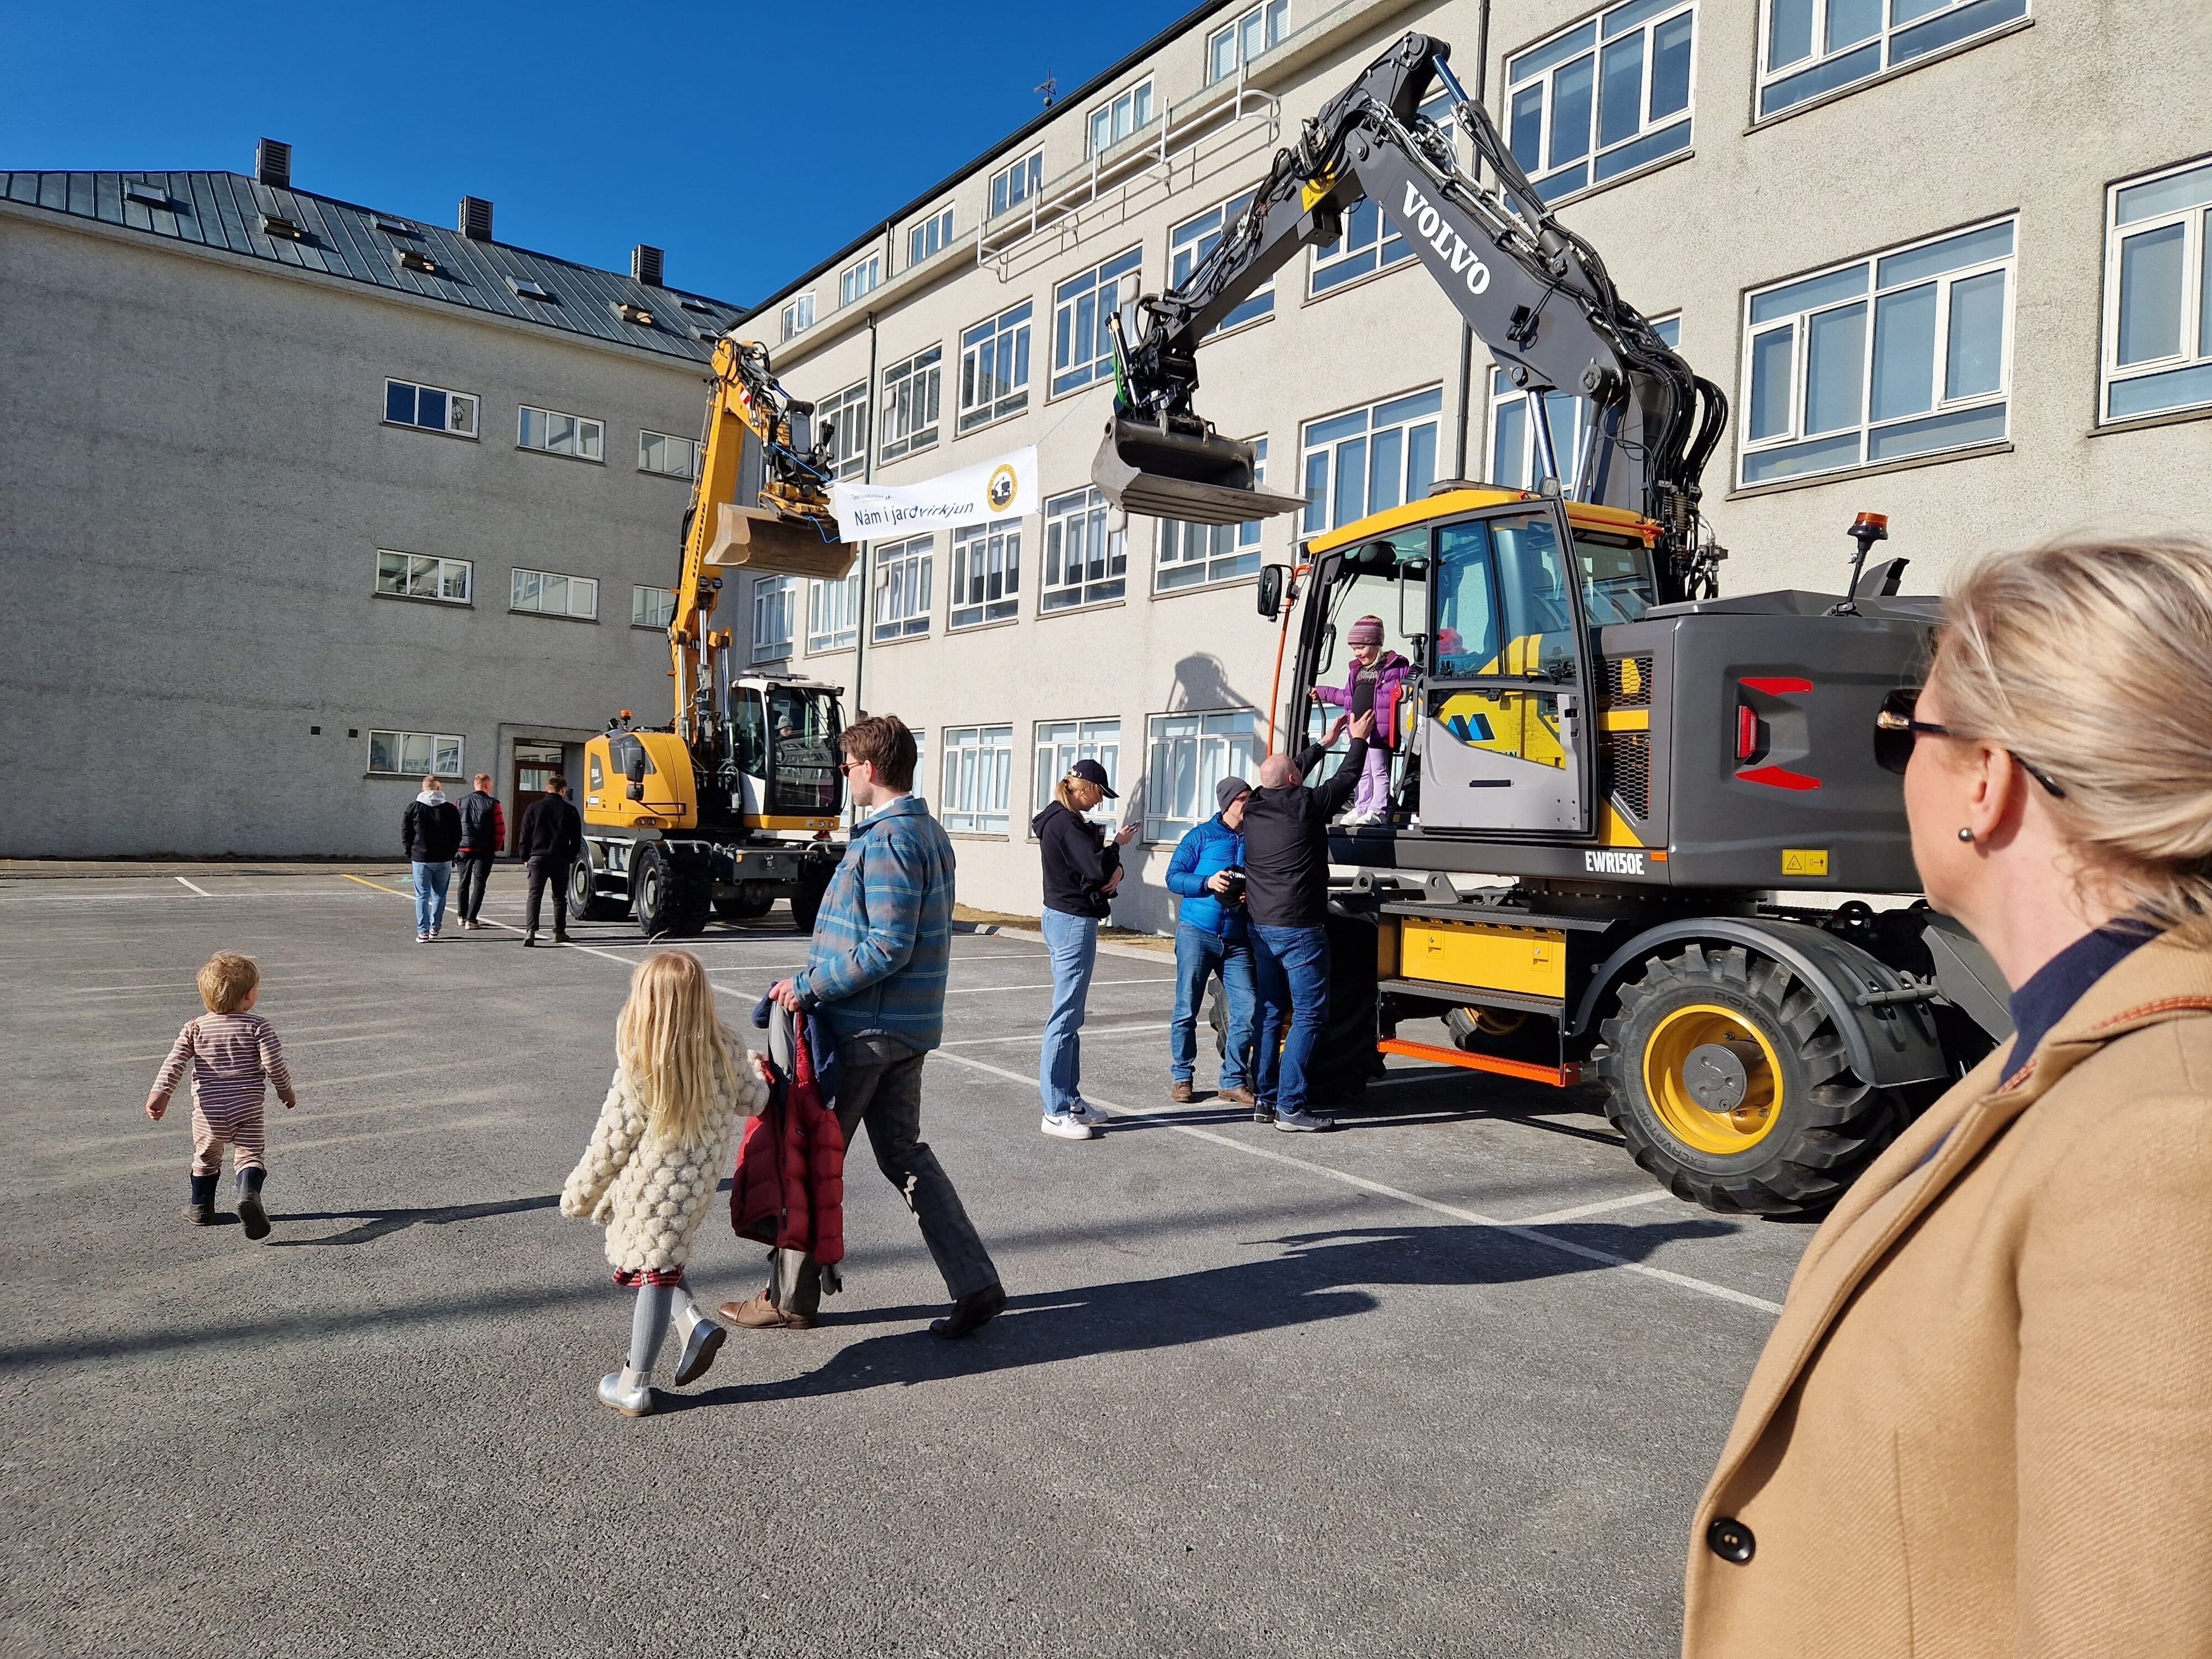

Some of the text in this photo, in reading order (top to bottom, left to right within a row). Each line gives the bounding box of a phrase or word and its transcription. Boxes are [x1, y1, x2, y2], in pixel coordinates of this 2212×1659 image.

[1402, 180, 1491, 295] VOLVO
[854, 509, 881, 527] Nám
[883, 506, 889, 522] í
[591, 768, 600, 778] 914
[1585, 851, 1645, 875] EWR150E
[1638, 1108, 1708, 1169] EXCAVATOR
